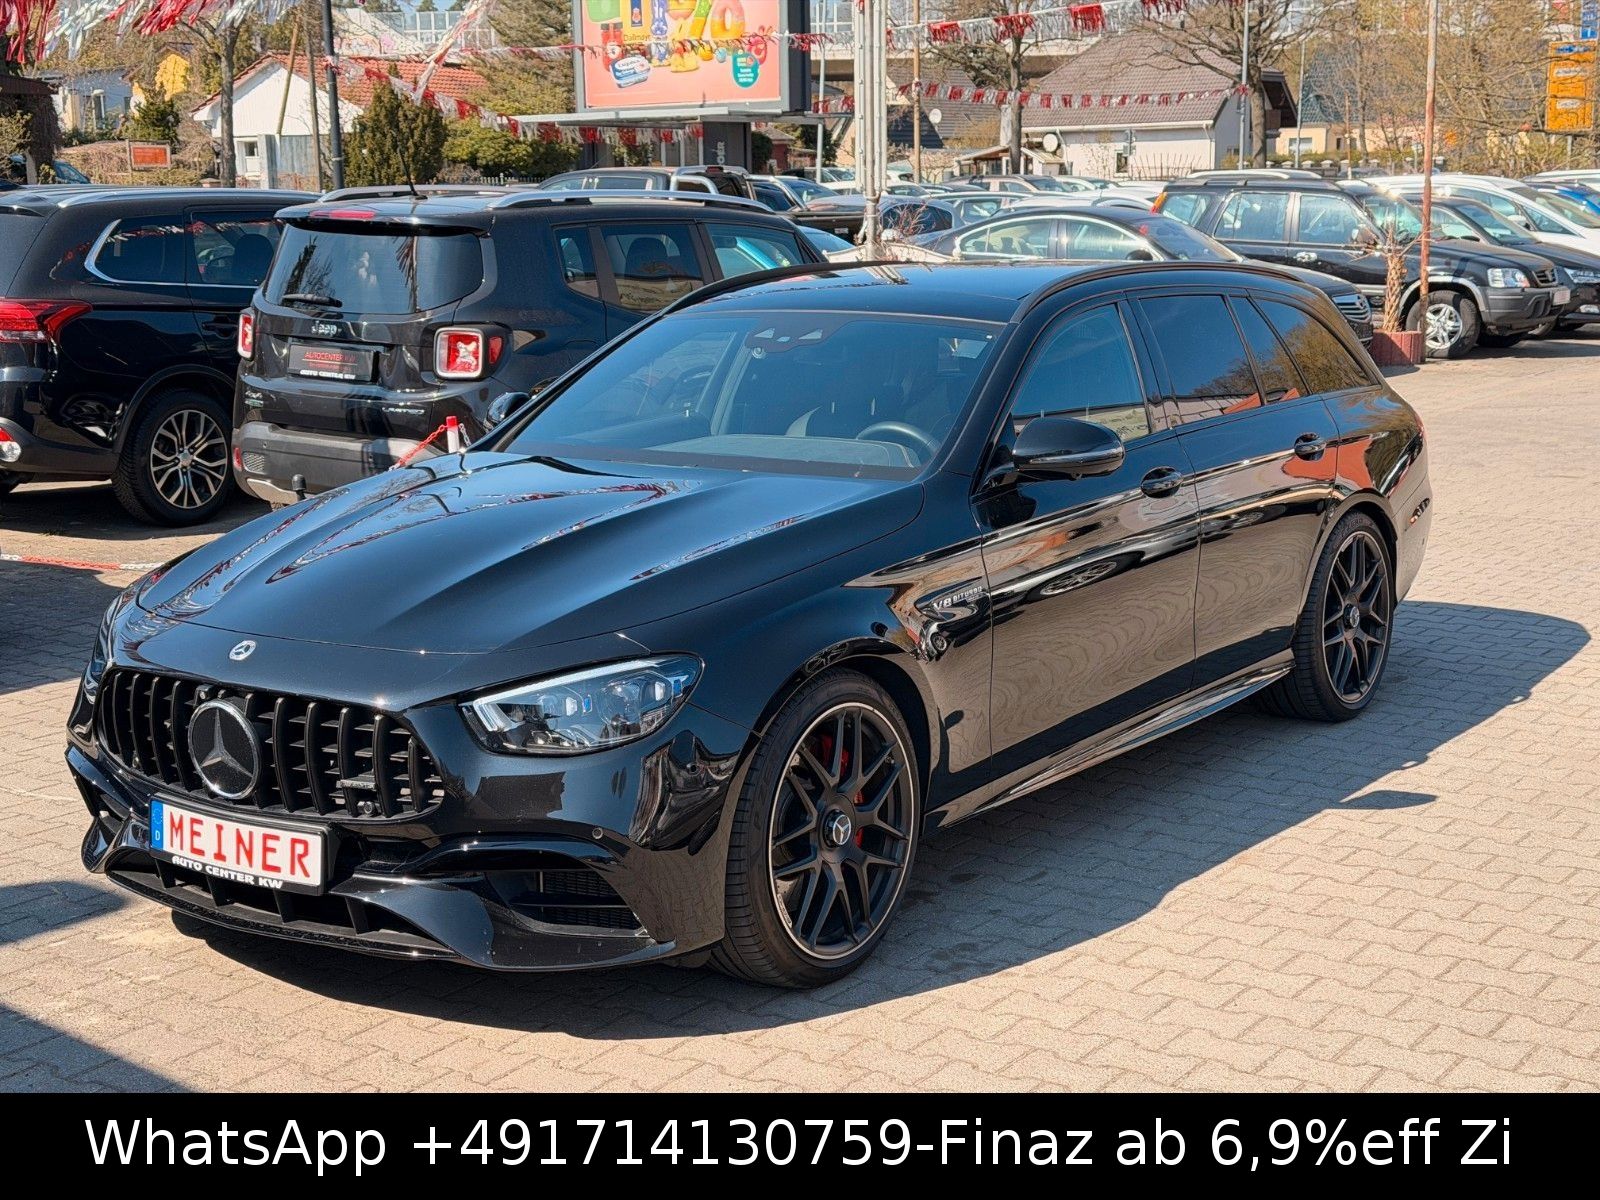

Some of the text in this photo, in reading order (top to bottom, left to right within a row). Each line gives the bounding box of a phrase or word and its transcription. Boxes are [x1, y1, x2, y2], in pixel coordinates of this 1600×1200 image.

[933, 597, 952, 611] V8
[953, 586, 983, 602] BITURBO
[155, 811, 310, 878] D MEINER
[171, 855, 284, 890] AUTO CENTER KW
